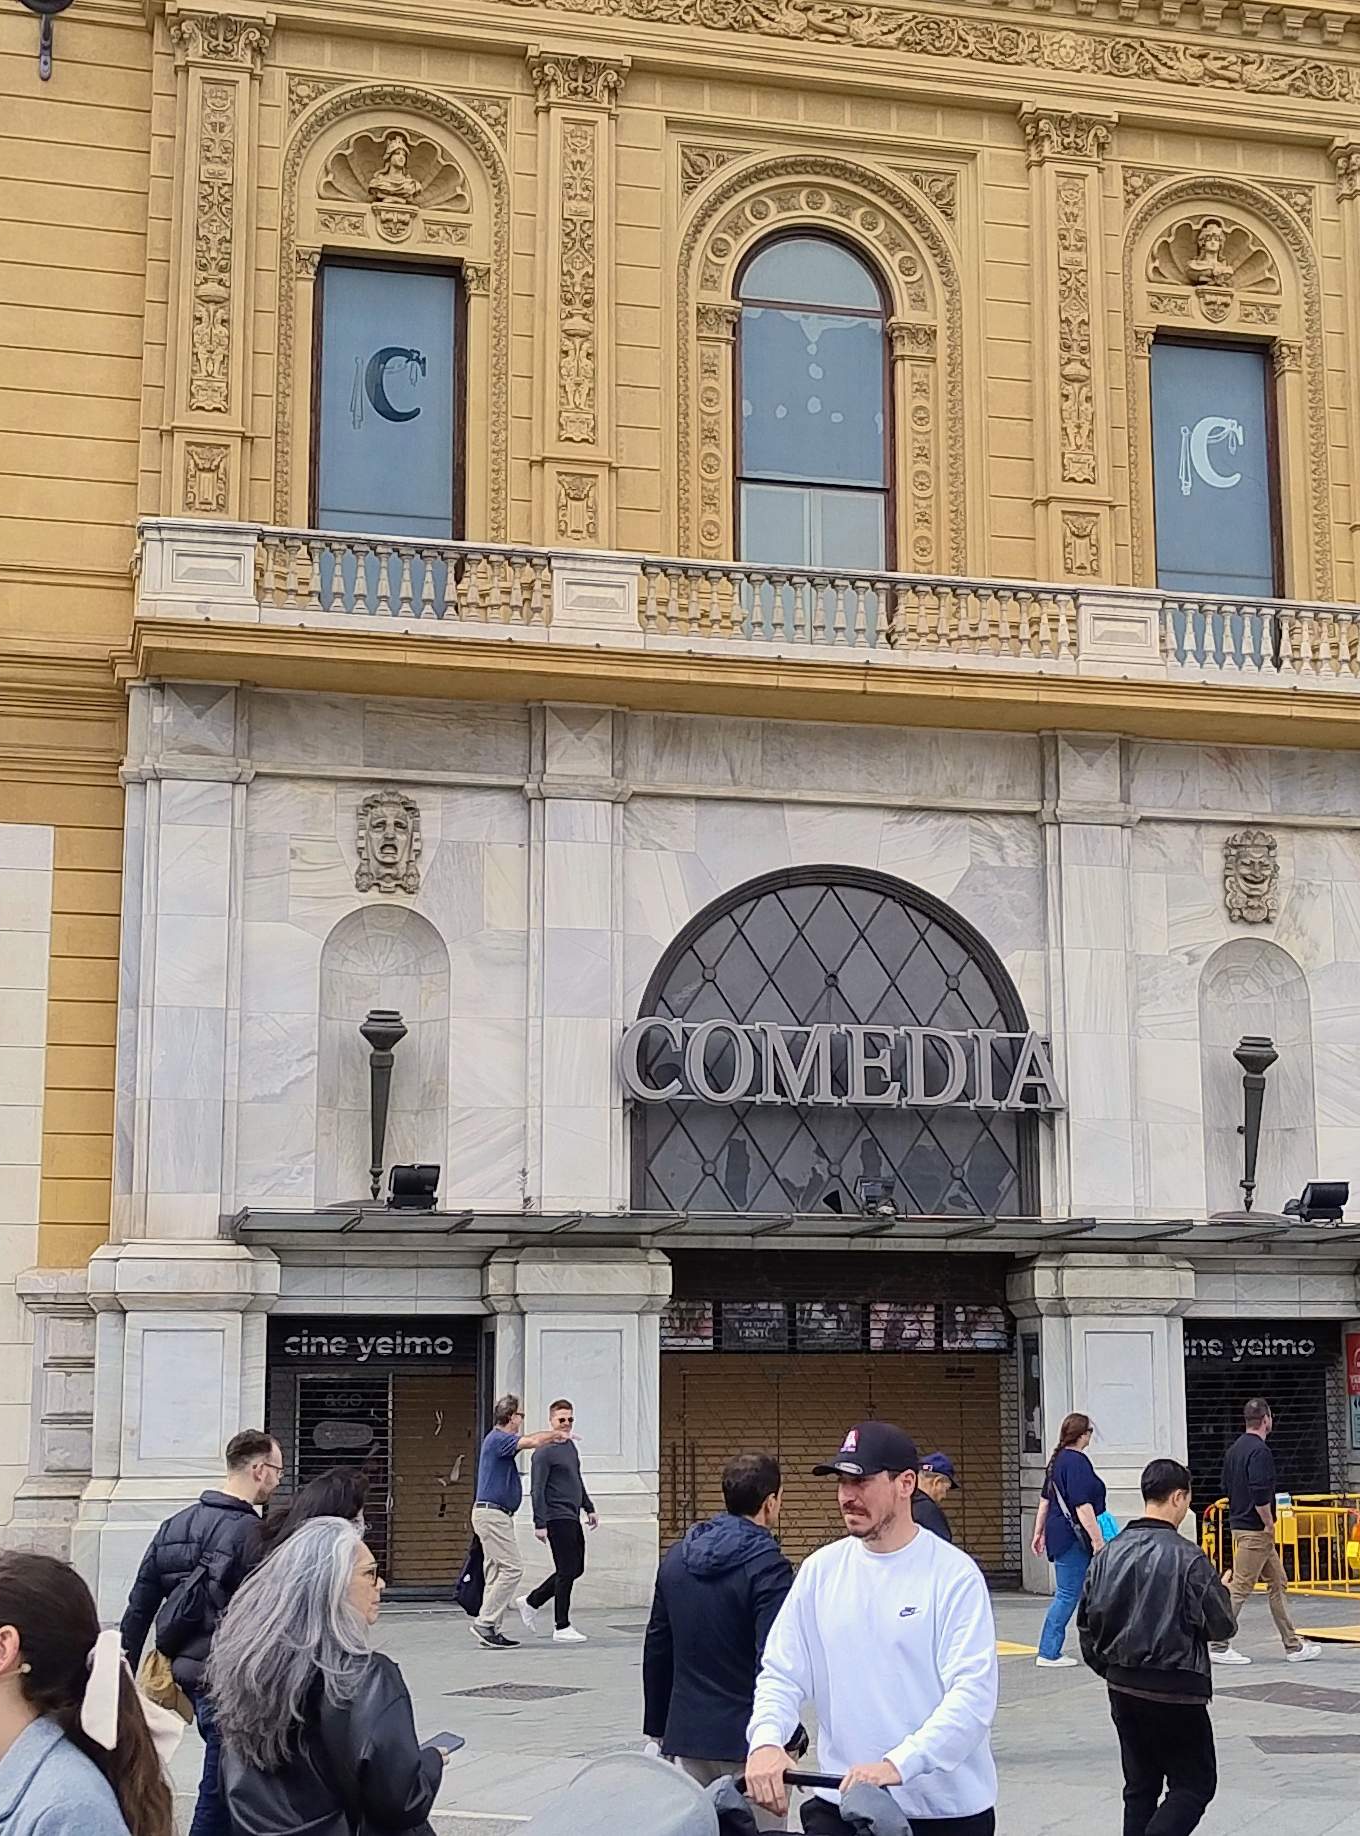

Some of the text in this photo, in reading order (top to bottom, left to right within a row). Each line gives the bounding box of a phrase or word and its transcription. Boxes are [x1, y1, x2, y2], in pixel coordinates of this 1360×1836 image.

[618, 1016, 1069, 1111] COMEDIA
[284, 1329, 348, 1356] cine
[1184, 1331, 1223, 1357] ine
